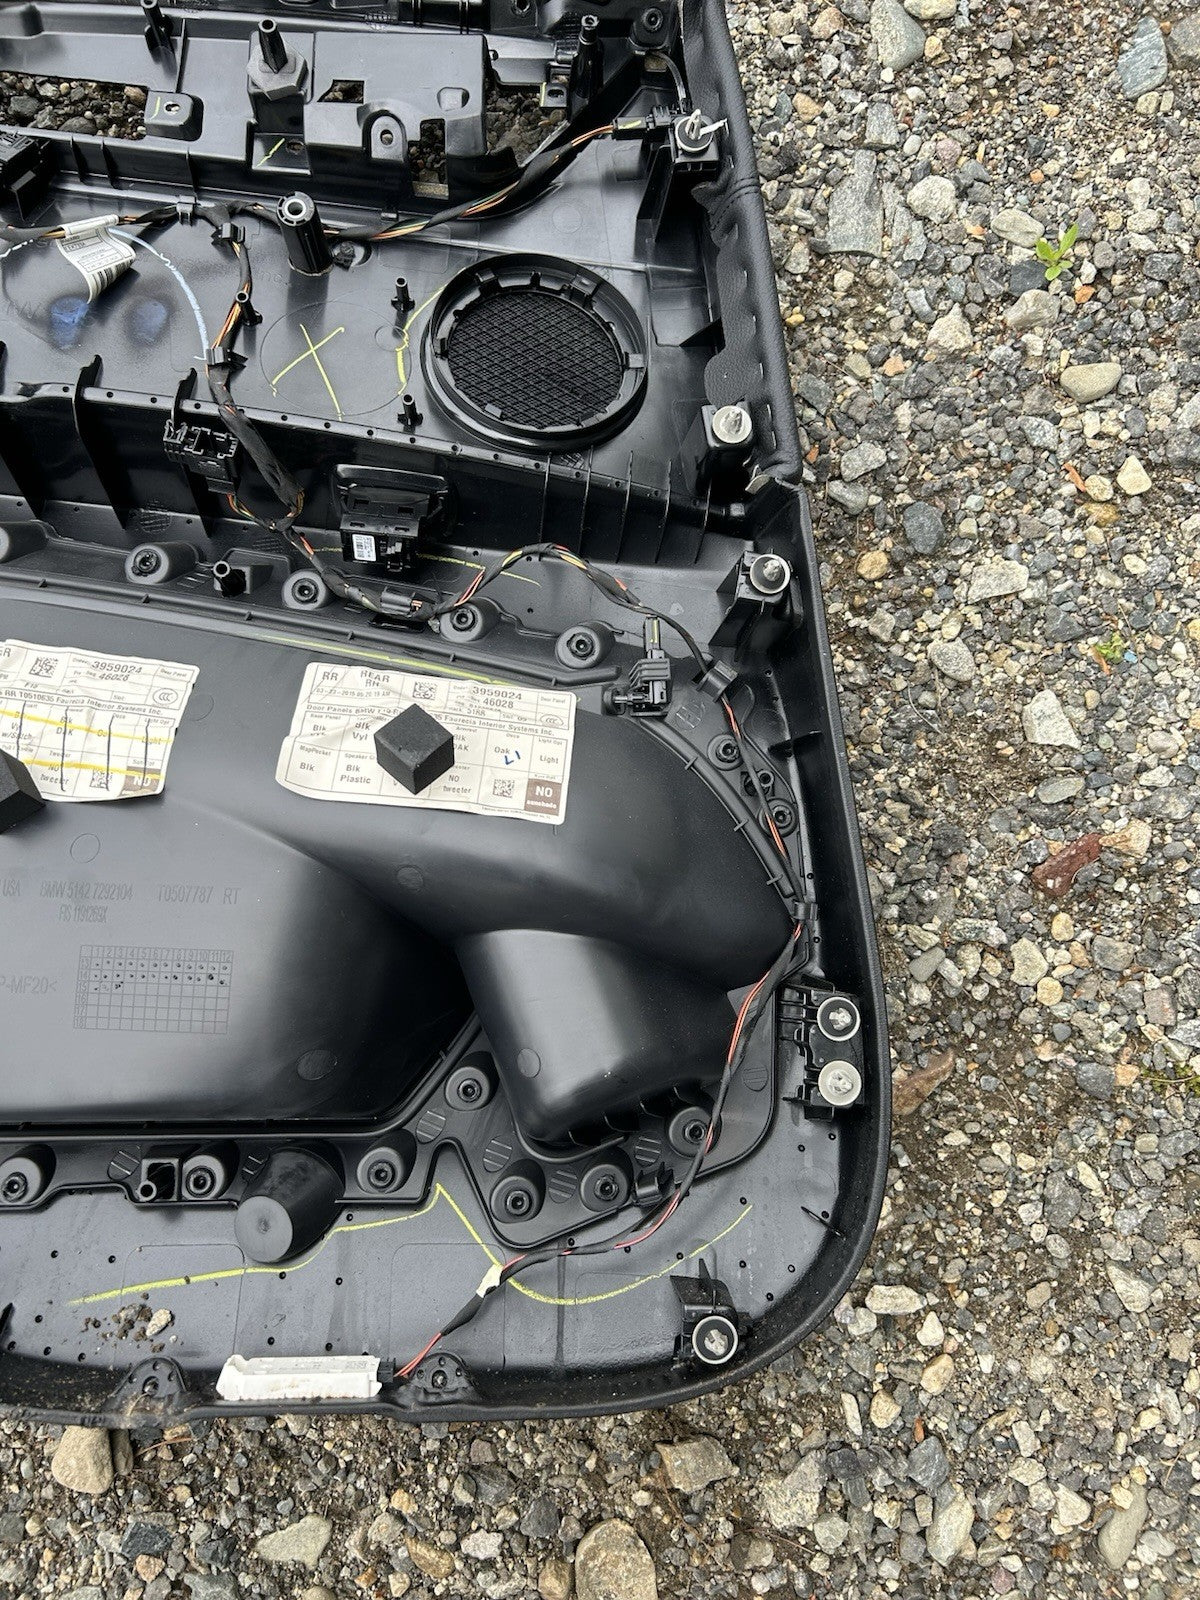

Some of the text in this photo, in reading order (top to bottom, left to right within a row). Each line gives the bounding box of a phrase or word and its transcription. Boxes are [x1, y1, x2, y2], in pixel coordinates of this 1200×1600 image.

[91, 660, 143, 674] 3959024
[98, 672, 130, 682] 46028
[322, 670, 390, 682] RR REAR
[472, 686, 522, 700] 3959024
[5, 689, 16, 697] RR
[56, 697, 85, 705] Faurecia
[87, 698, 115, 710] Interior
[117, 704, 147, 713] Systems
[149, 708, 163, 716] Inc.
[483, 698, 514, 709] 46028
[444, 715, 476, 726] Faurecia
[479, 720, 506, 729] Interior
[509, 724, 538, 734] Systems
[541, 728, 554, 736] Inc.
[352, 732, 368, 741] Vyl
[494, 746, 511, 754] Oak
[539, 754, 559, 764] Light
[300, 762, 315, 771] Blk
[346, 765, 361, 773] Blk
[340, 774, 372, 784] Plastic
[449, 774, 460, 783] NO
[535, 785, 553, 798] NO
[223, 887, 241, 905] RT
